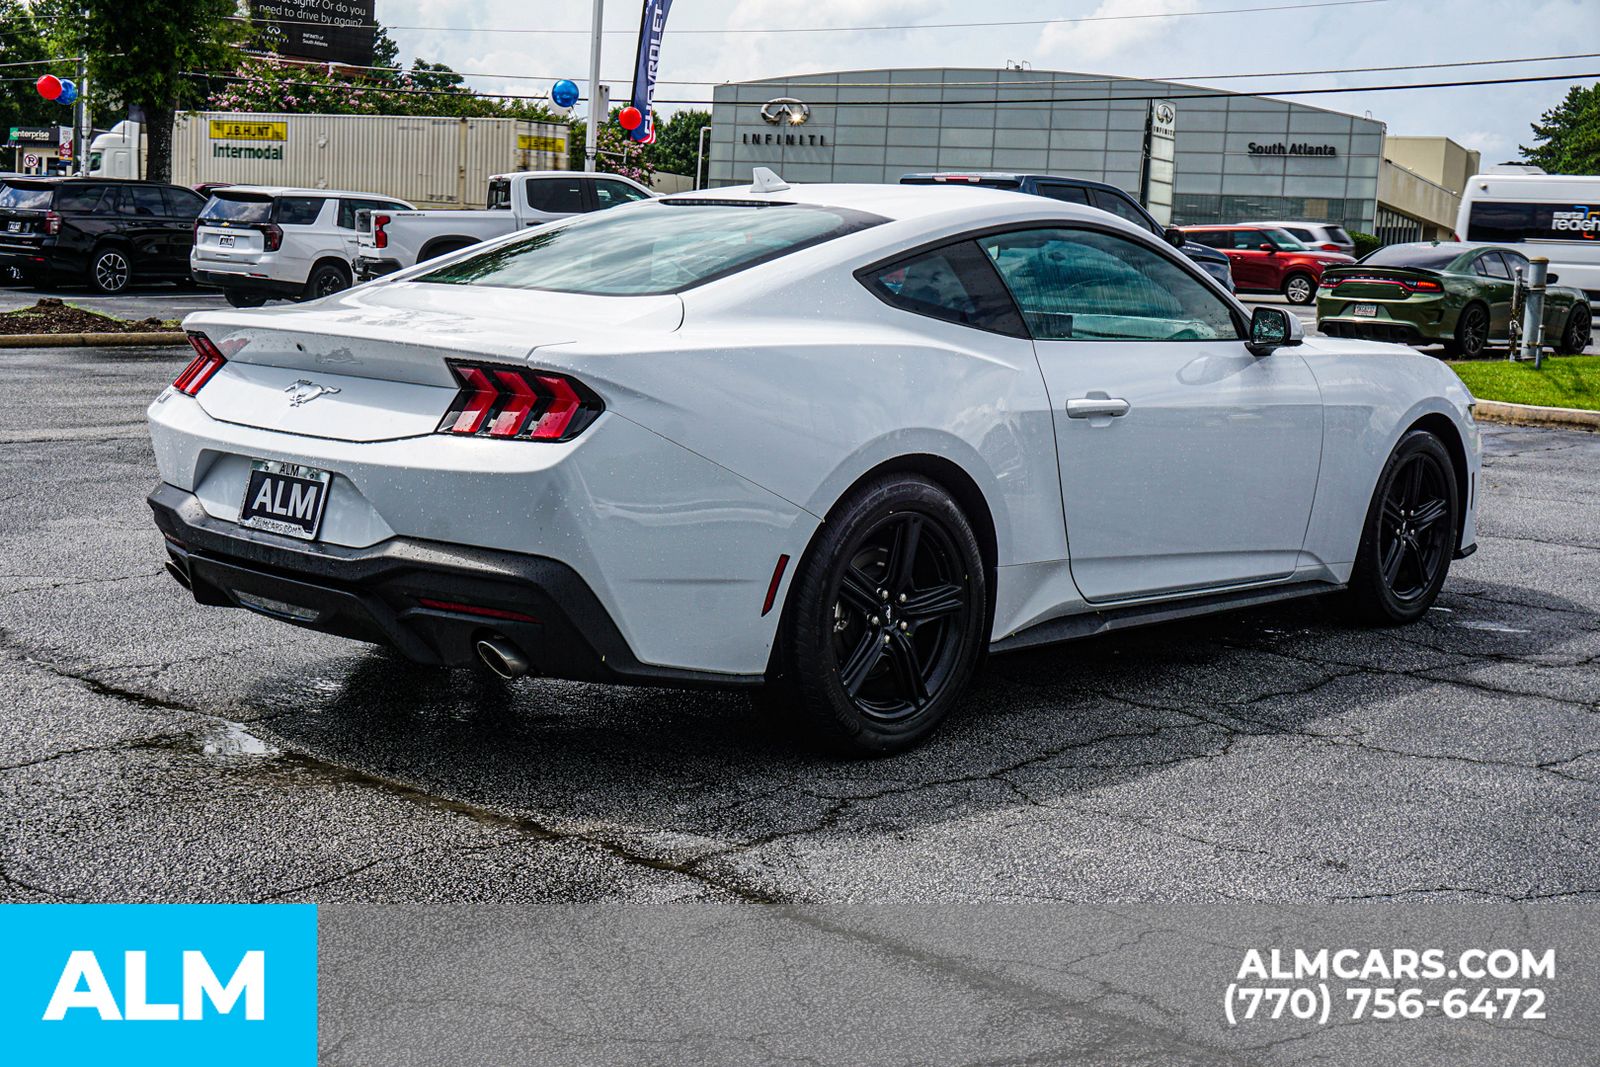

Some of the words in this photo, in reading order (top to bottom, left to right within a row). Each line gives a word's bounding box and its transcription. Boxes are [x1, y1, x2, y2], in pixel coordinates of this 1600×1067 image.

[321, 0, 335, 10] Or
[336, 2, 348, 12] do
[350, 5, 366, 16] you
[259, 4, 282, 15] need
[284, 7, 295, 17] to
[296, 9, 319, 21] drive
[321, 12, 332, 24] by
[334, 18, 363, 28] again?
[12, 130, 49, 139] enterprise
[743, 133, 825, 146] INFINITI
[213, 143, 283, 160] Intermodal
[1248, 142, 1286, 155] South
[1289, 143, 1336, 155] Atlanta
[279, 463, 300, 477] ALM
[252, 478, 318, 520] ALM
